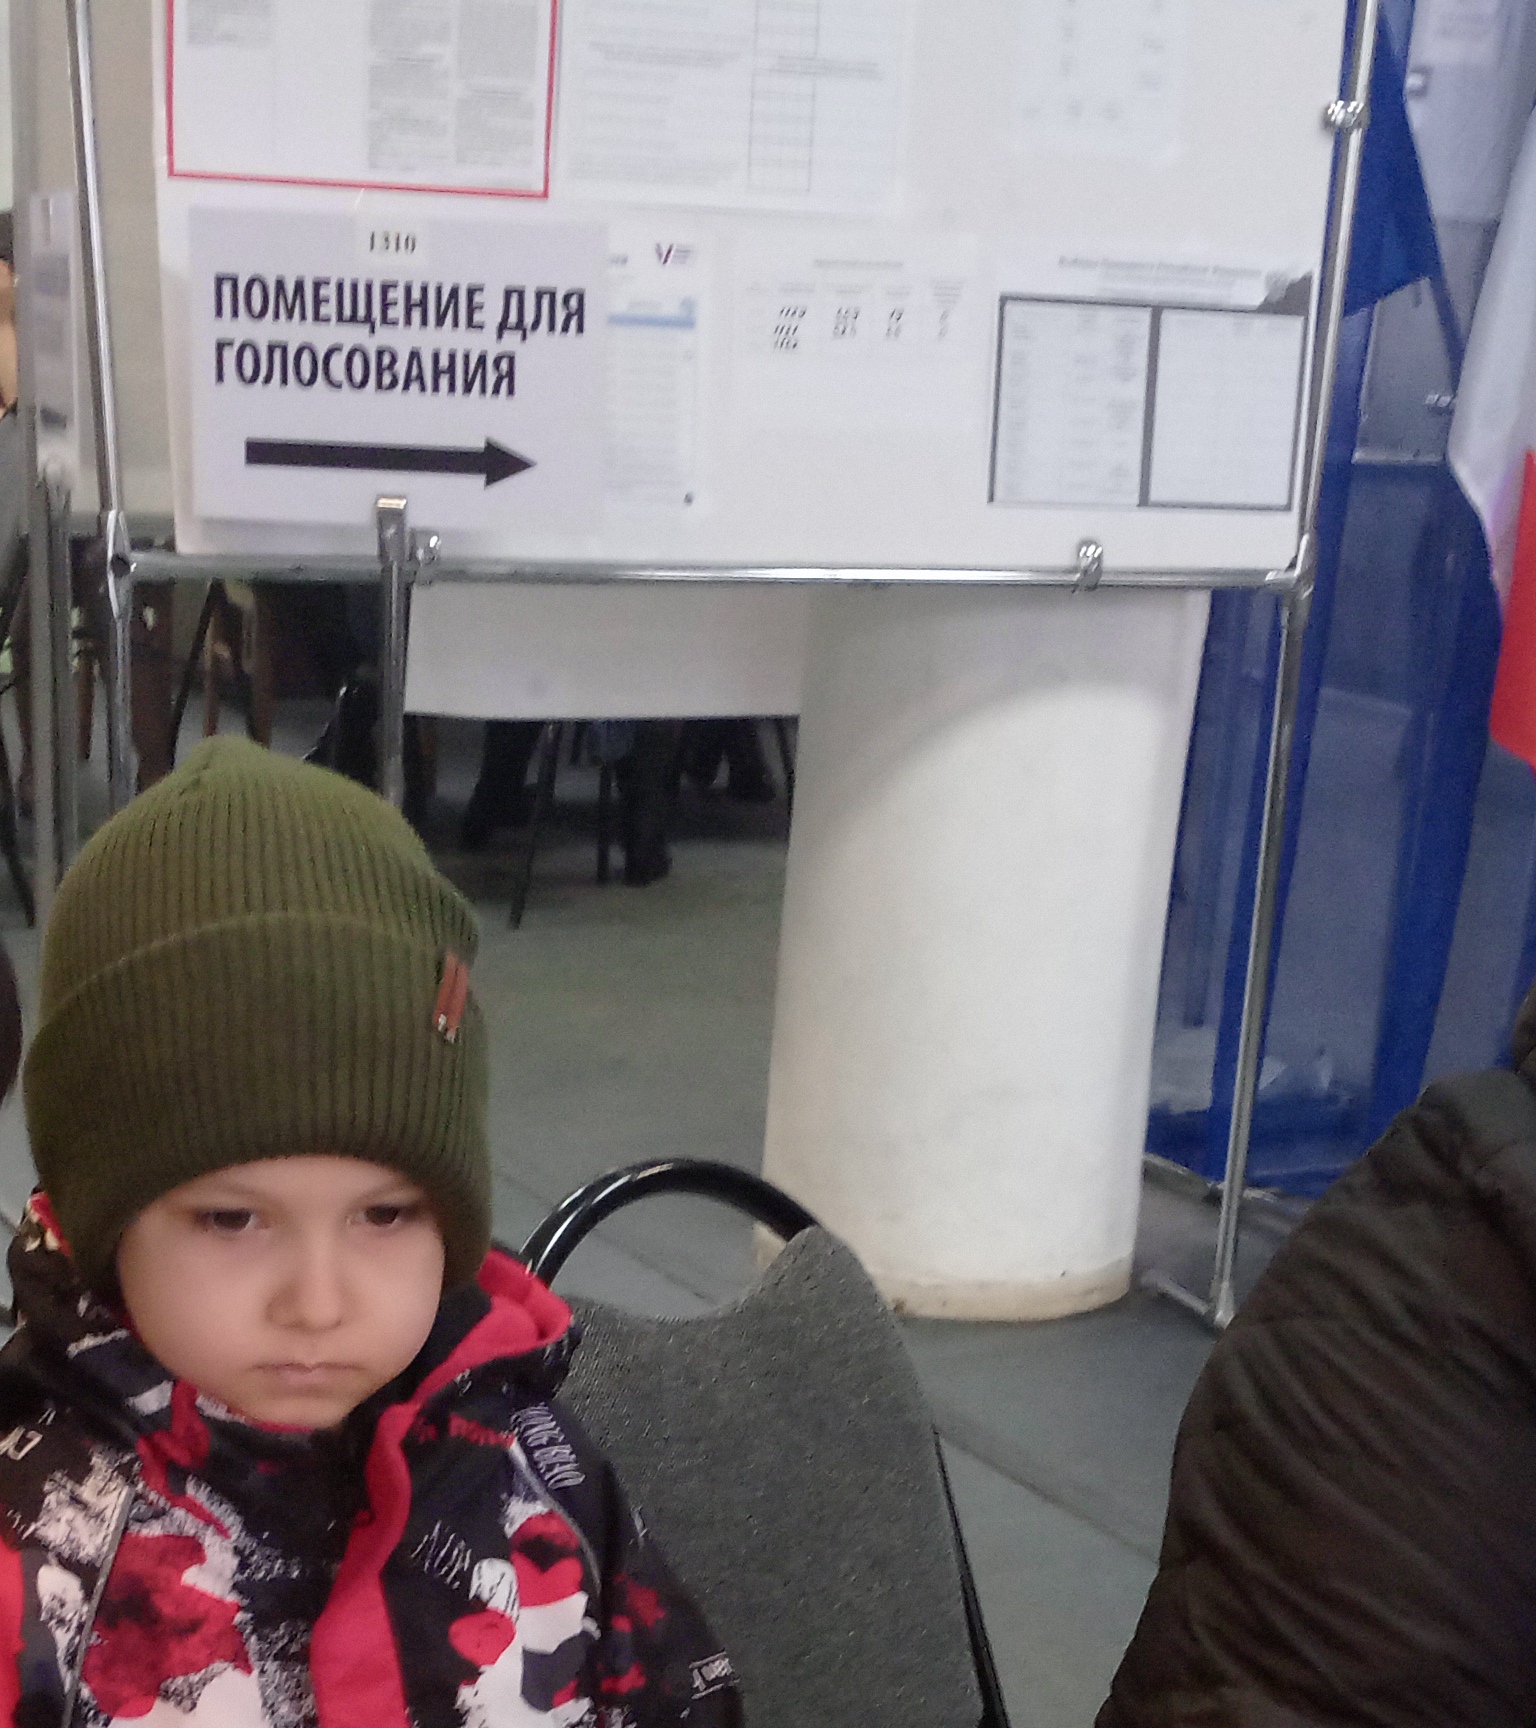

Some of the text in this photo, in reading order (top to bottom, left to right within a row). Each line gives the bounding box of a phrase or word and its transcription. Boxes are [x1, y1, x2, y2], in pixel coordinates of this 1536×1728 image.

[213, 271, 586, 344] ПОМЕЩЕНИЕ ДЛЯ
[214, 337, 516, 400] ГОЛОСОВАНИЯ
